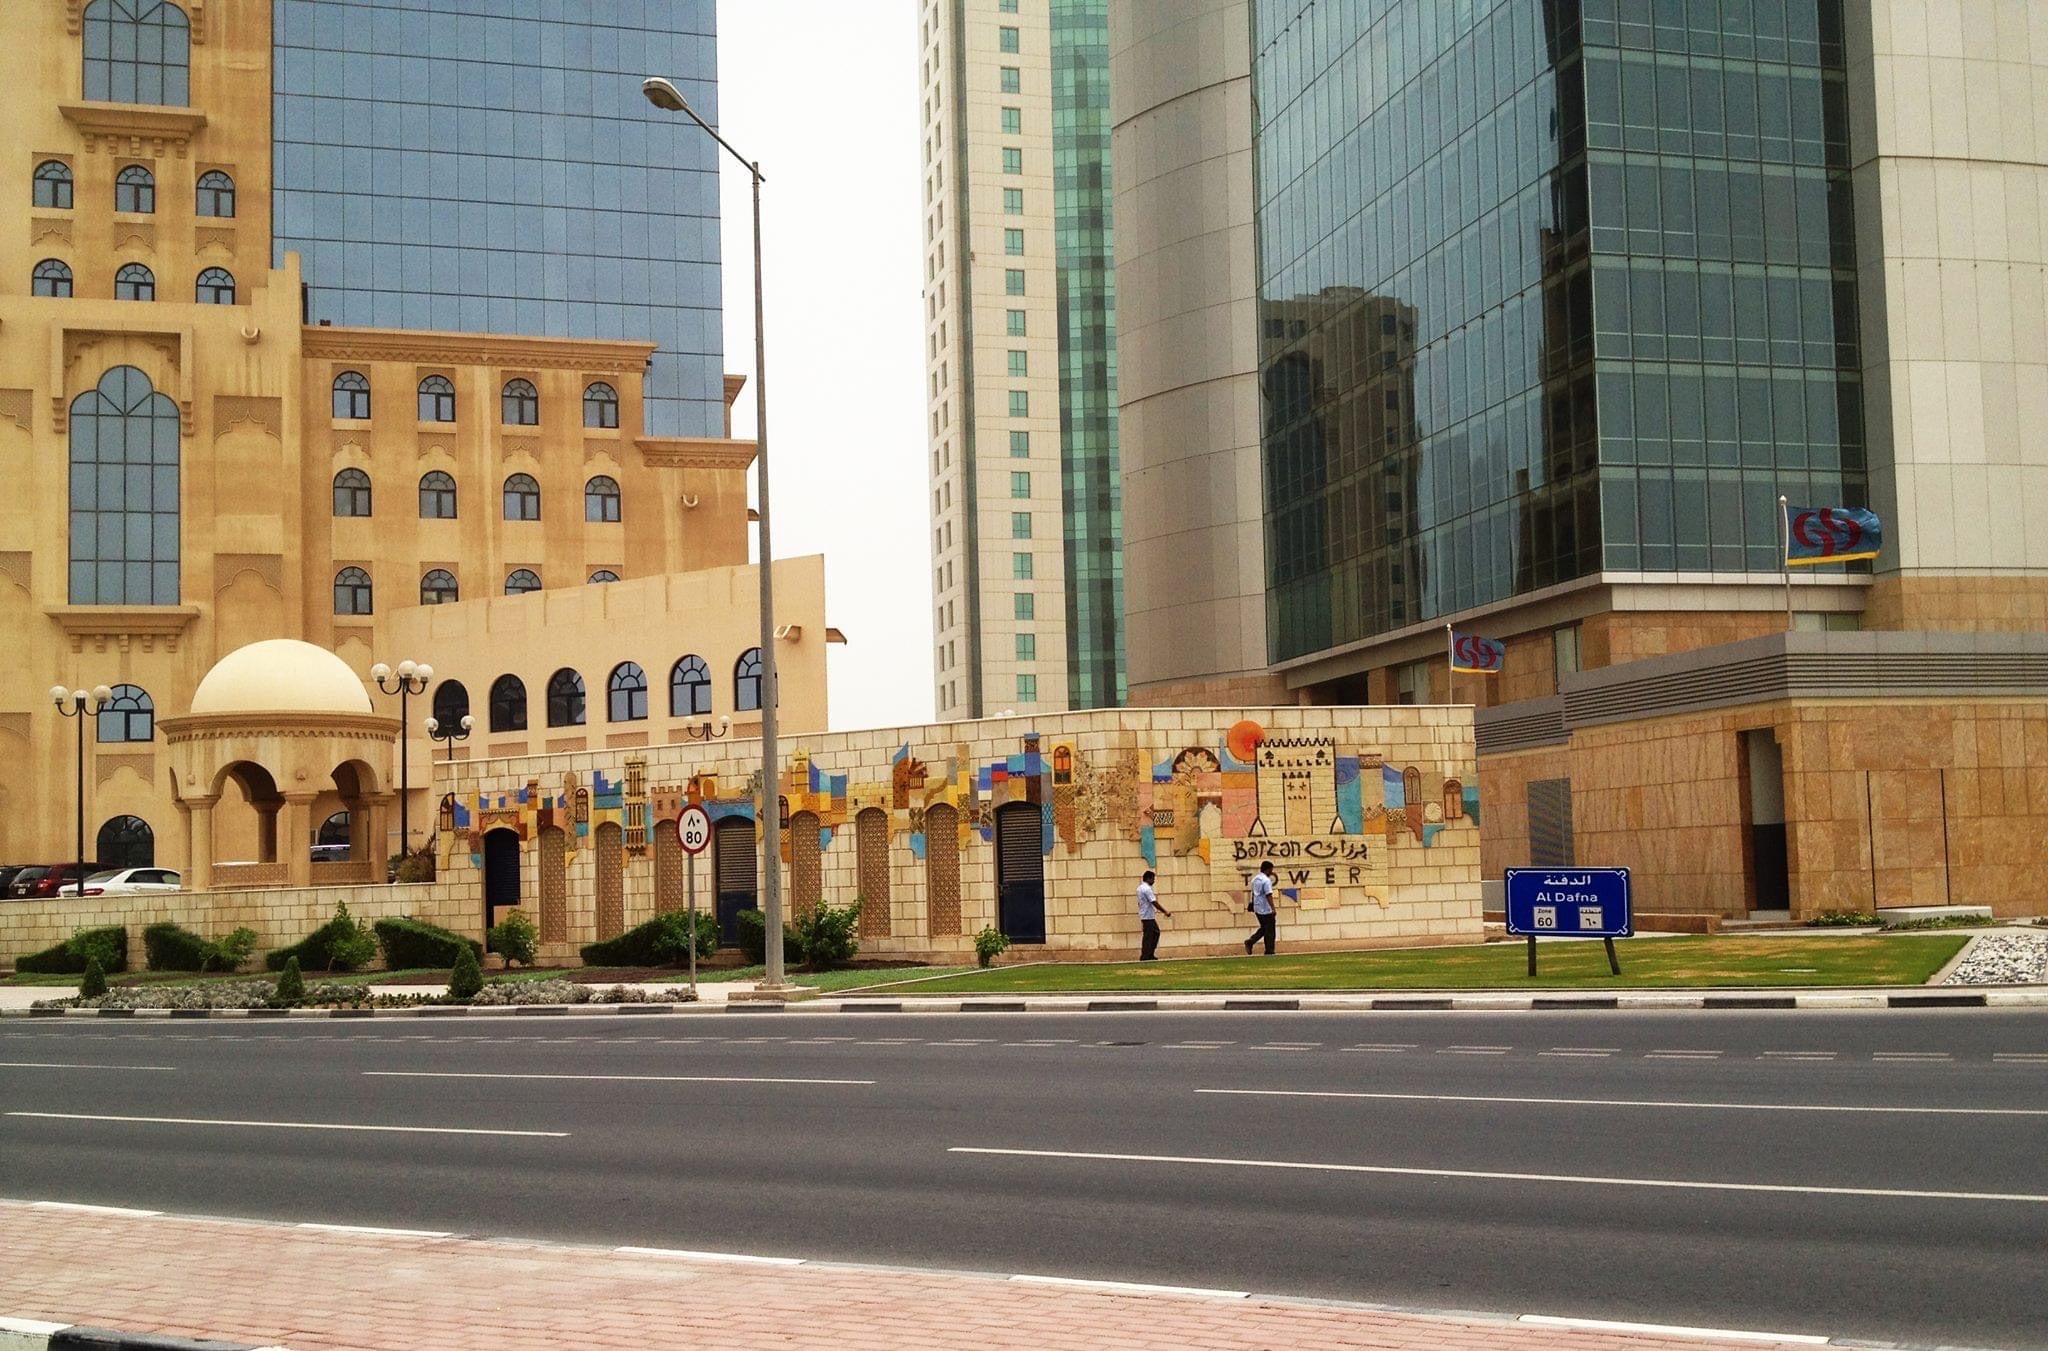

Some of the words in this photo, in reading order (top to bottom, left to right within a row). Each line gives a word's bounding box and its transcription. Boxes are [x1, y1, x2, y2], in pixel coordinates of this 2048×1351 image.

[687, 814, 700, 827] ٨٠
[686, 831, 702, 844] 80
[1232, 840, 1301, 861] Barzan
[1543, 874, 1591, 886] الدفنة
[1536, 892, 1552, 903] Al
[1555, 892, 1599, 903] Dafna
[1537, 917, 1553, 927] 60
[1585, 918, 1597, 927] ٦٠
